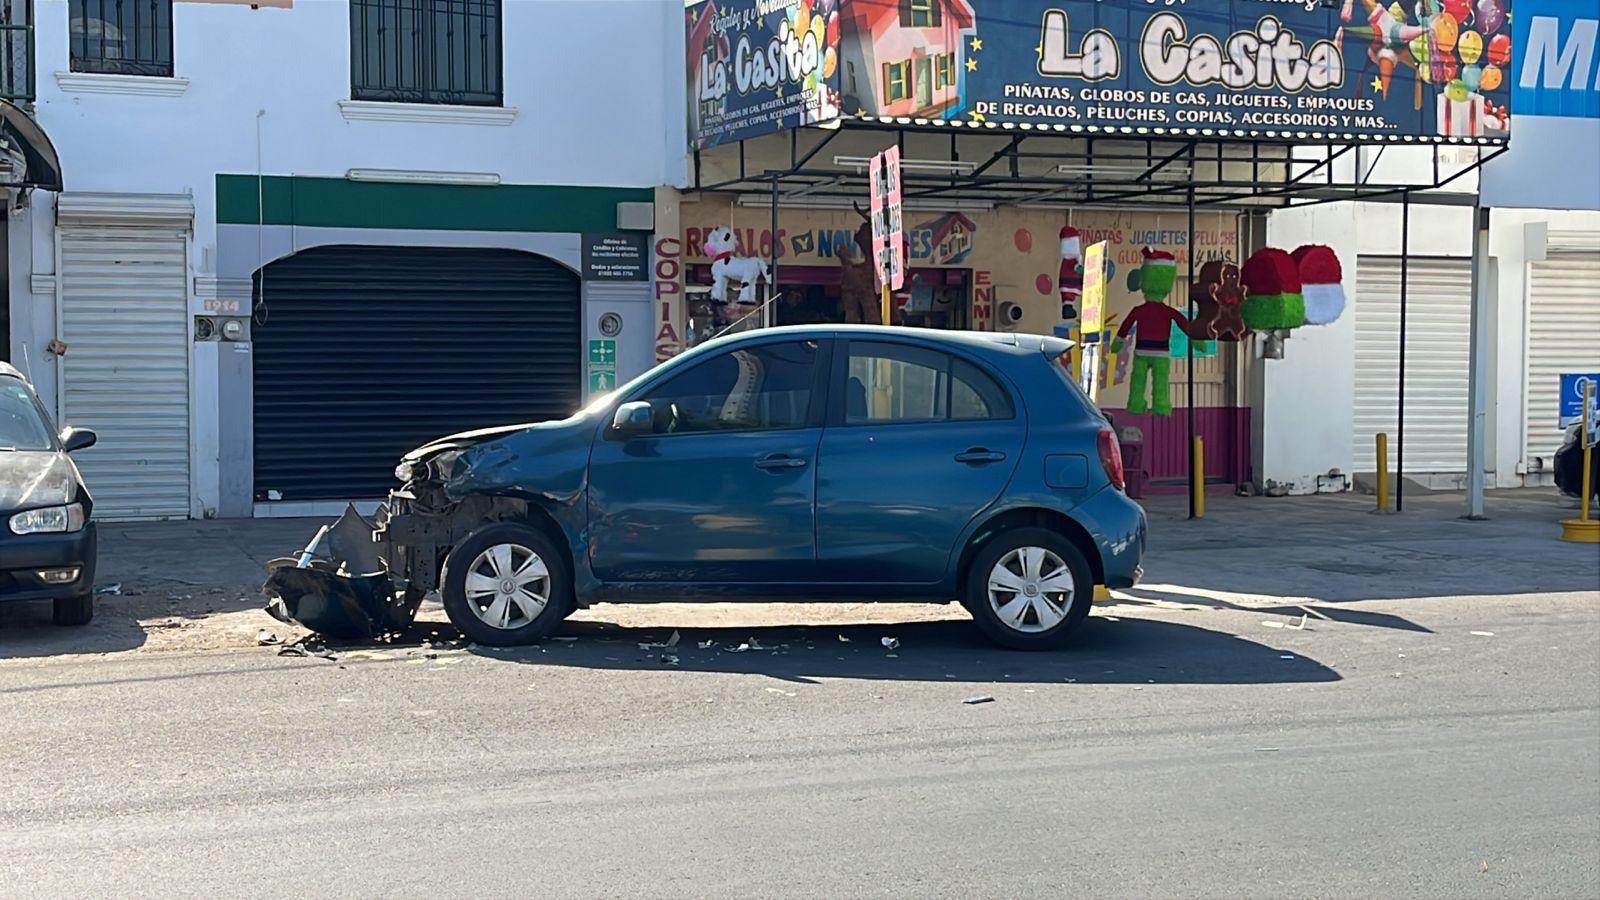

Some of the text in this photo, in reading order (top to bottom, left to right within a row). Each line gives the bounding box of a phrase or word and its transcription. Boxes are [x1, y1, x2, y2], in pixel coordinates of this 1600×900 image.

[700, 21, 818, 101] La Casita
[1039, 10, 1343, 92] La Casita
[1519, 16, 1600, 91] M
[976, 102, 1398, 129] DE REGALOS, PELUCHES, COPIAS, ACCESORIOS Y MAS...
[1004, 83, 1374, 112] PIÑATAS, GLOBOS DE GAS, JUGUETES, EMPAQUES
[1130, 230, 1187, 245] JUGUETES
[204, 299, 239, 311] 1914
[655, 237, 680, 363] COPIAS
